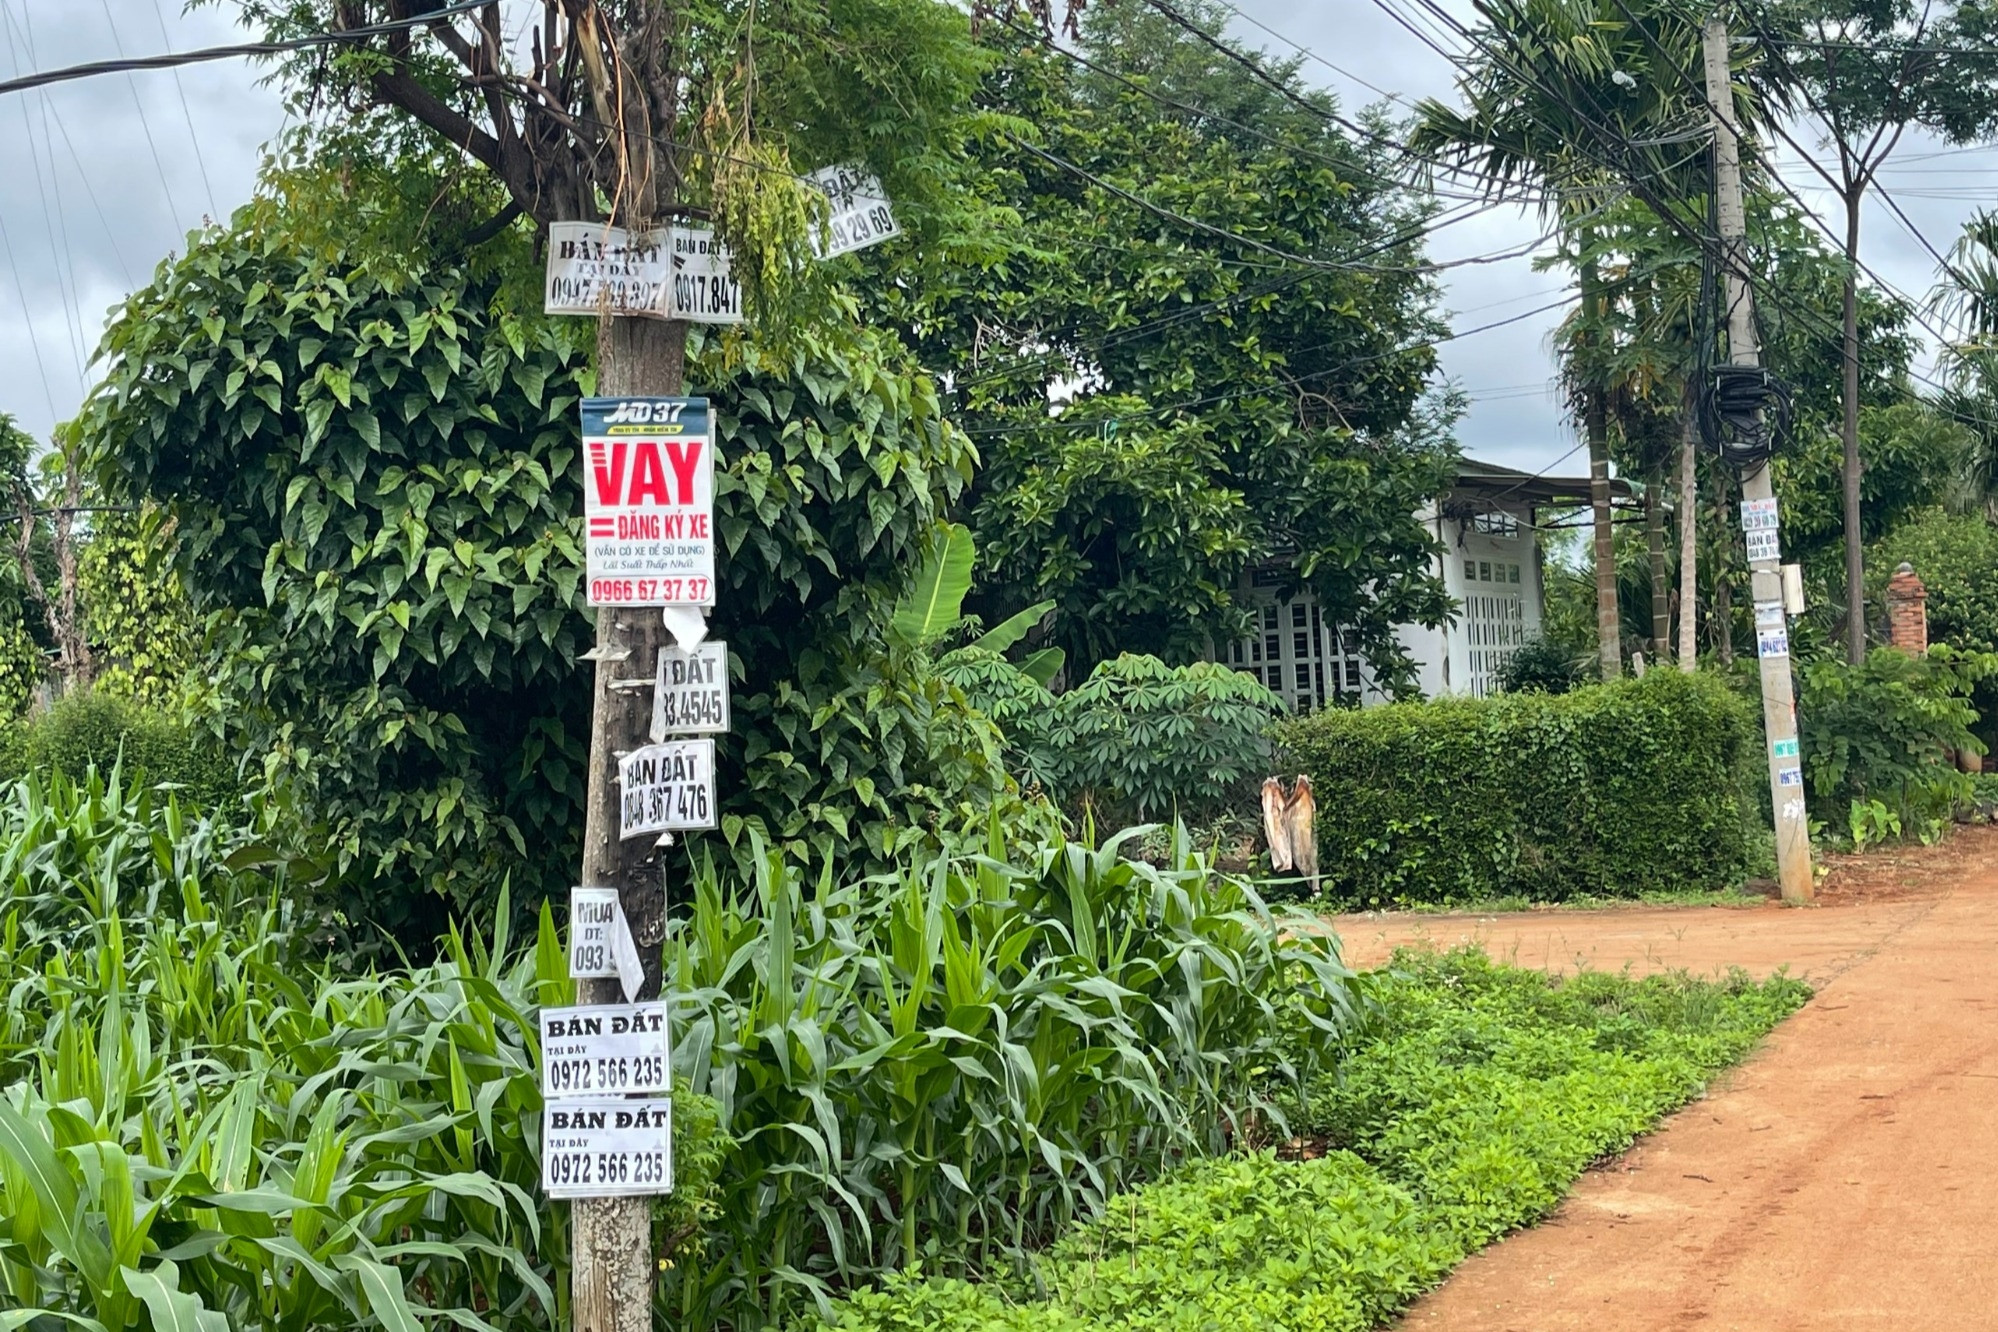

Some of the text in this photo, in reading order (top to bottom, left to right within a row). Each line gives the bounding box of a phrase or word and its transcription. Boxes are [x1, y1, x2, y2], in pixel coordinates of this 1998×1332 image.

[846, 213, 871, 242] 29
[869, 206, 893, 235] 69
[589, 442, 703, 506] VAY
[618, 509, 660, 540] ĐĂNG
[664, 509, 684, 539] KÝ
[689, 514, 708, 539] XE
[620, 545, 631, 556] CÓ
[635, 546, 645, 556] XE
[592, 579, 708, 601] 0966 67 37 37
[661, 745, 697, 782] ĐẤT
[649, 786, 672, 824] 367
[678, 784, 707, 820] 476
[578, 902, 613, 924] MUA
[575, 945, 604, 971] 093
[548, 1009, 663, 1038] BÁN ĐẤT
[548, 1044, 587, 1057] TẠI ĐÂY
[551, 1056, 662, 1090] 0972 566 235
[551, 1104, 666, 1129] BÁN ĐẤT
[549, 1137, 589, 1149] TẠI ĐÂY
[551, 1152, 663, 1184] 0972 566 235
